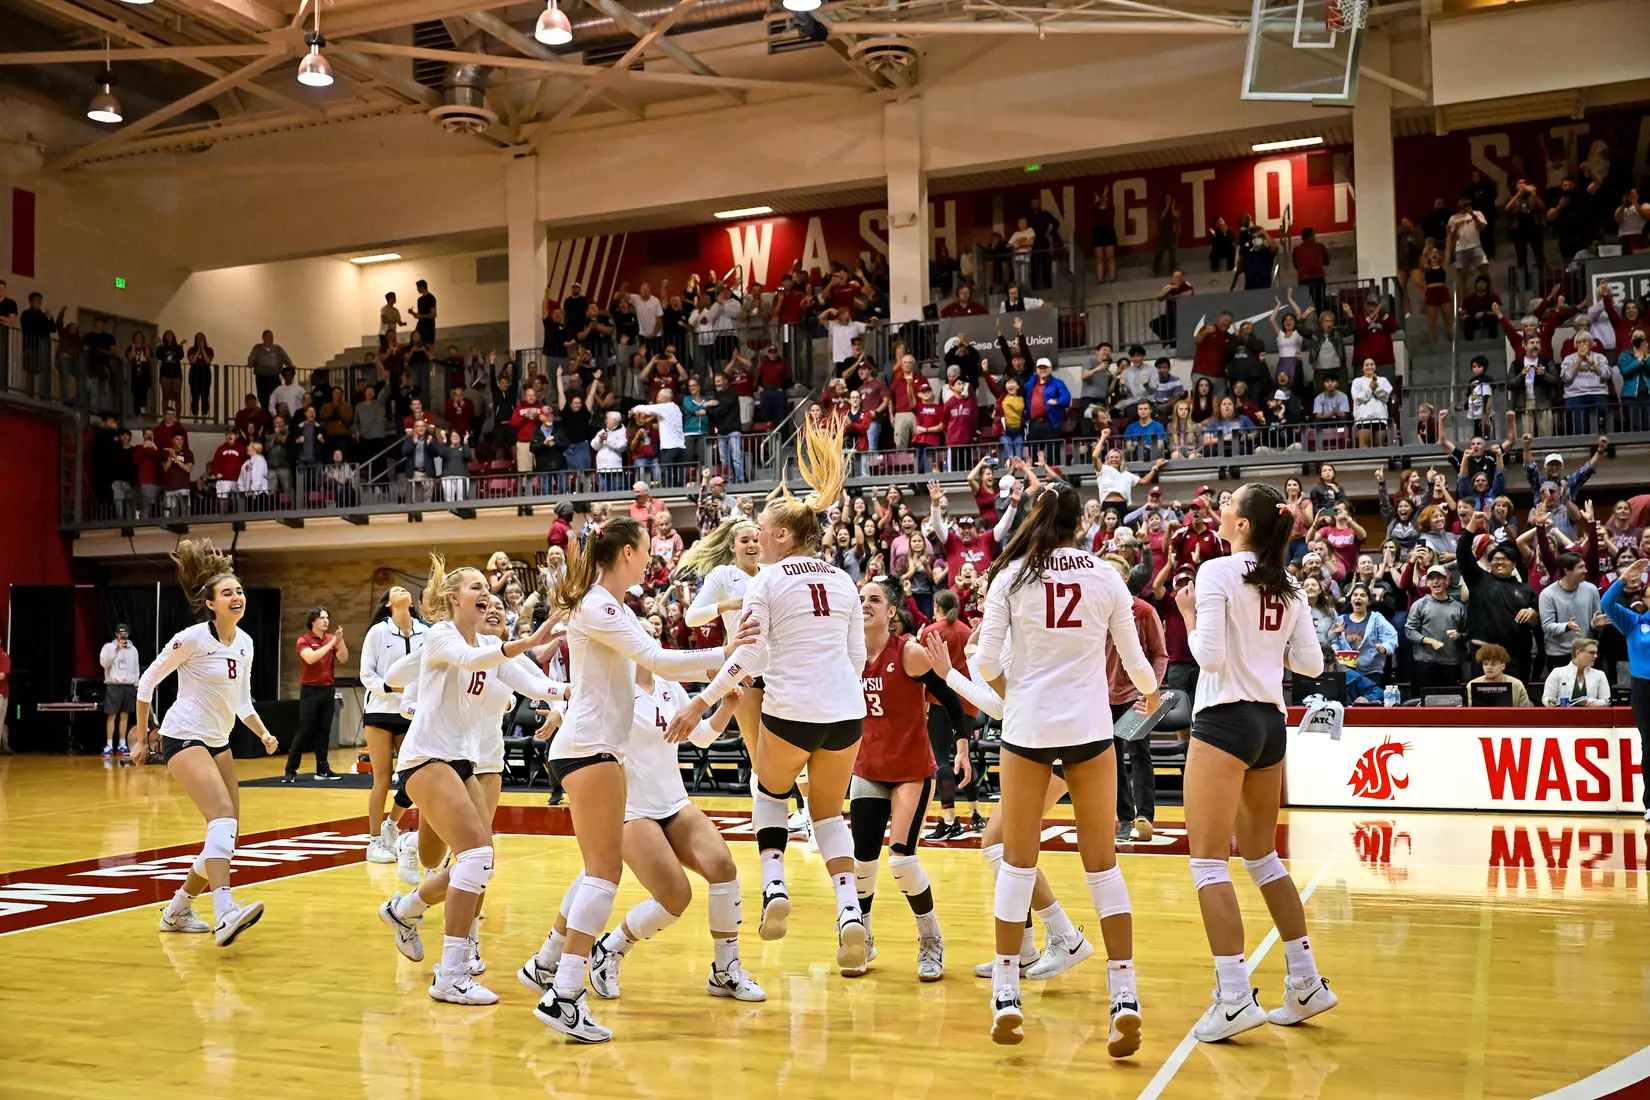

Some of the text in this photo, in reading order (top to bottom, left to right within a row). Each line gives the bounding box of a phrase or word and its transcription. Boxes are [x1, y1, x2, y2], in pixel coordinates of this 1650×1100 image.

[1025, 335, 1053, 347] Union
[781, 561, 836, 576] COUGARS
[806, 583, 831, 617] 11
[1043, 582, 1083, 629] 12
[1259, 588, 1285, 631] 15
[226, 658, 238, 680] 8
[467, 670, 487, 696] 16
[655, 706, 668, 731] 4
